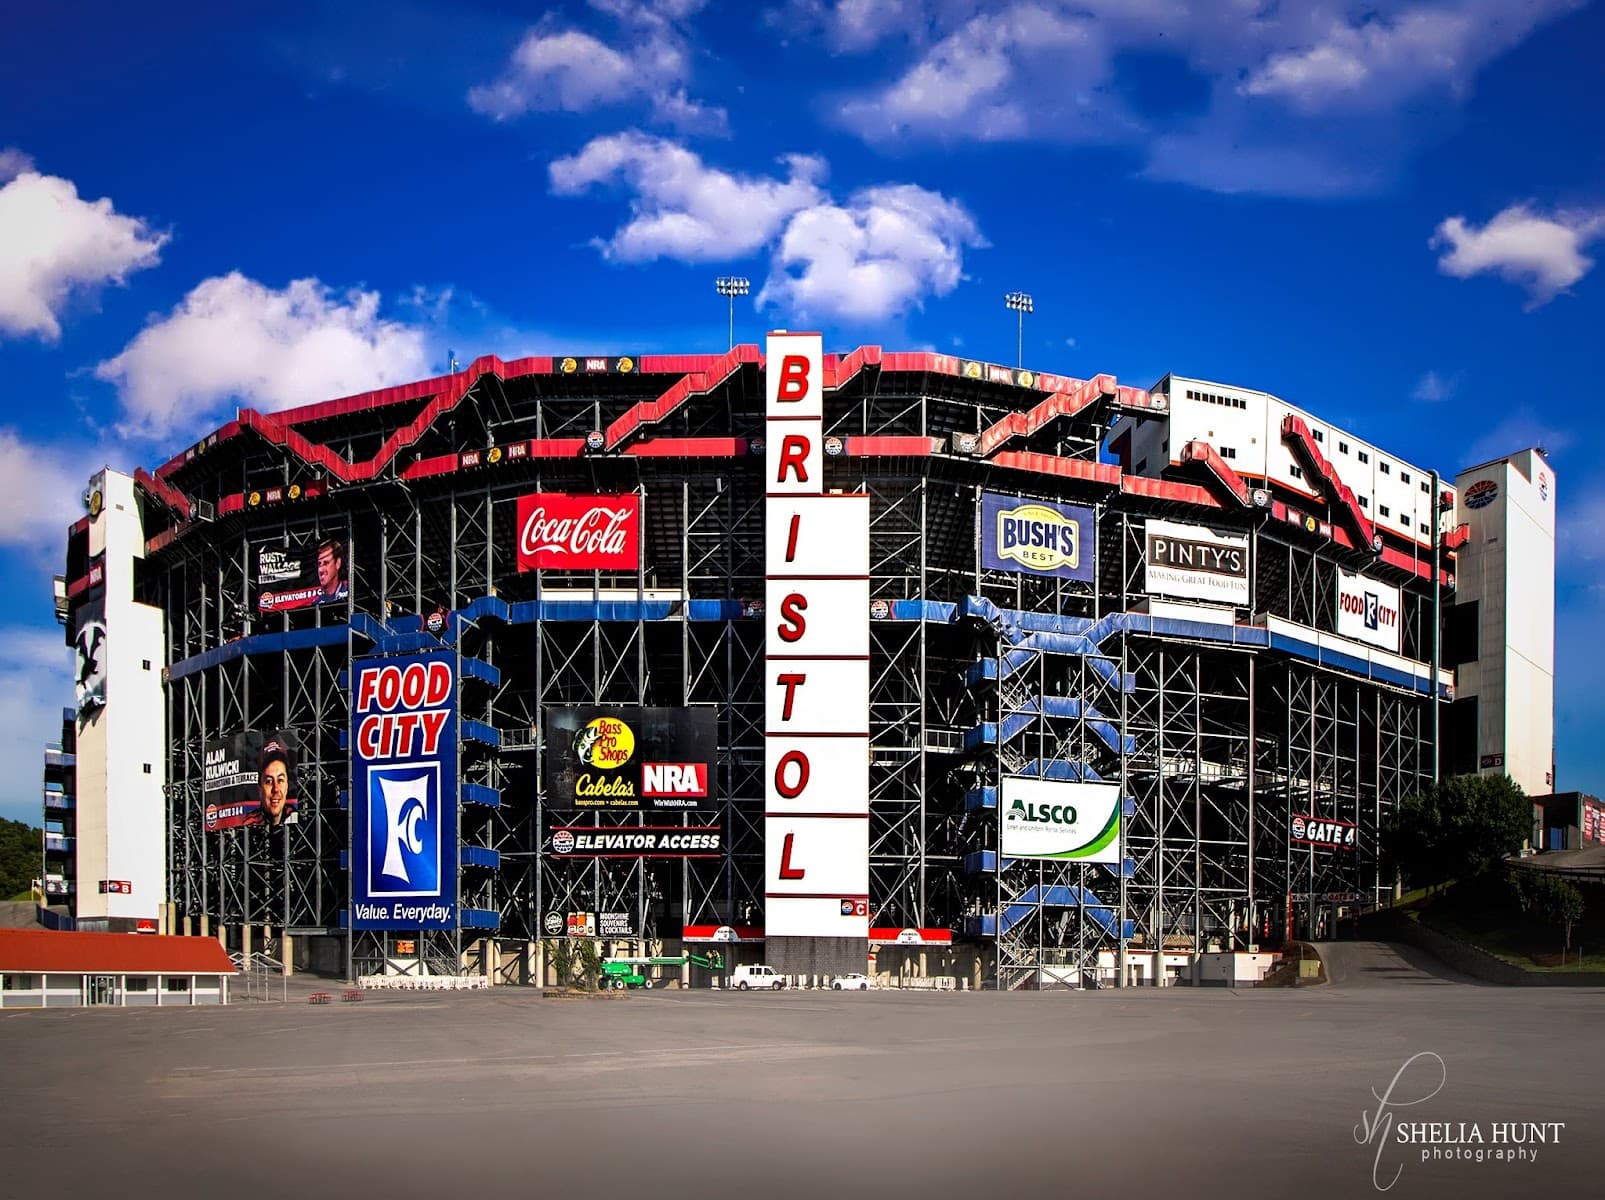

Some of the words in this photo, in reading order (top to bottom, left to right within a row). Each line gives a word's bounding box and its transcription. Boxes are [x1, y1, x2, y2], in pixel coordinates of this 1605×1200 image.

[586, 359, 606, 370] NRA
[462, 453, 479, 465] NRA
[521, 507, 634, 555] Coca-Cola
[1003, 517, 1074, 557] BUSH'S
[259, 552, 286, 564] RUSTY
[1022, 551, 1055, 562] BEST
[1155, 540, 1241, 572] PINTY'S
[259, 560, 301, 575] WALLACE
[275, 591, 306, 603] ELEVATORS
[774, 354, 811, 881] BRISTOL
[1339, 592, 1364, 616] FOOD
[1378, 605, 1397, 628] CITY
[357, 661, 453, 713] FOOD
[357, 709, 452, 760] CITY
[598, 720, 622, 735] Bass
[599, 734, 617, 748] Pro
[206, 748, 226, 766] ALAN
[598, 747, 629, 765] Shops
[205, 760, 240, 780] KULWICKI
[643, 764, 701, 793] NRA
[575, 773, 634, 797] Cabela's
[218, 808, 232, 818] GATE
[1005, 799, 1077, 825] ALSCO
[575, 834, 655, 849] ELEVATOR
[658, 834, 721, 849] ACCESS
[1306, 821, 1343, 844] GATE
[1344, 827, 1355, 846] 4
[121, 884, 130, 893] B
[356, 904, 390, 920] Value.
[393, 903, 451, 923] Everyday.
[856, 904, 865, 915] C
